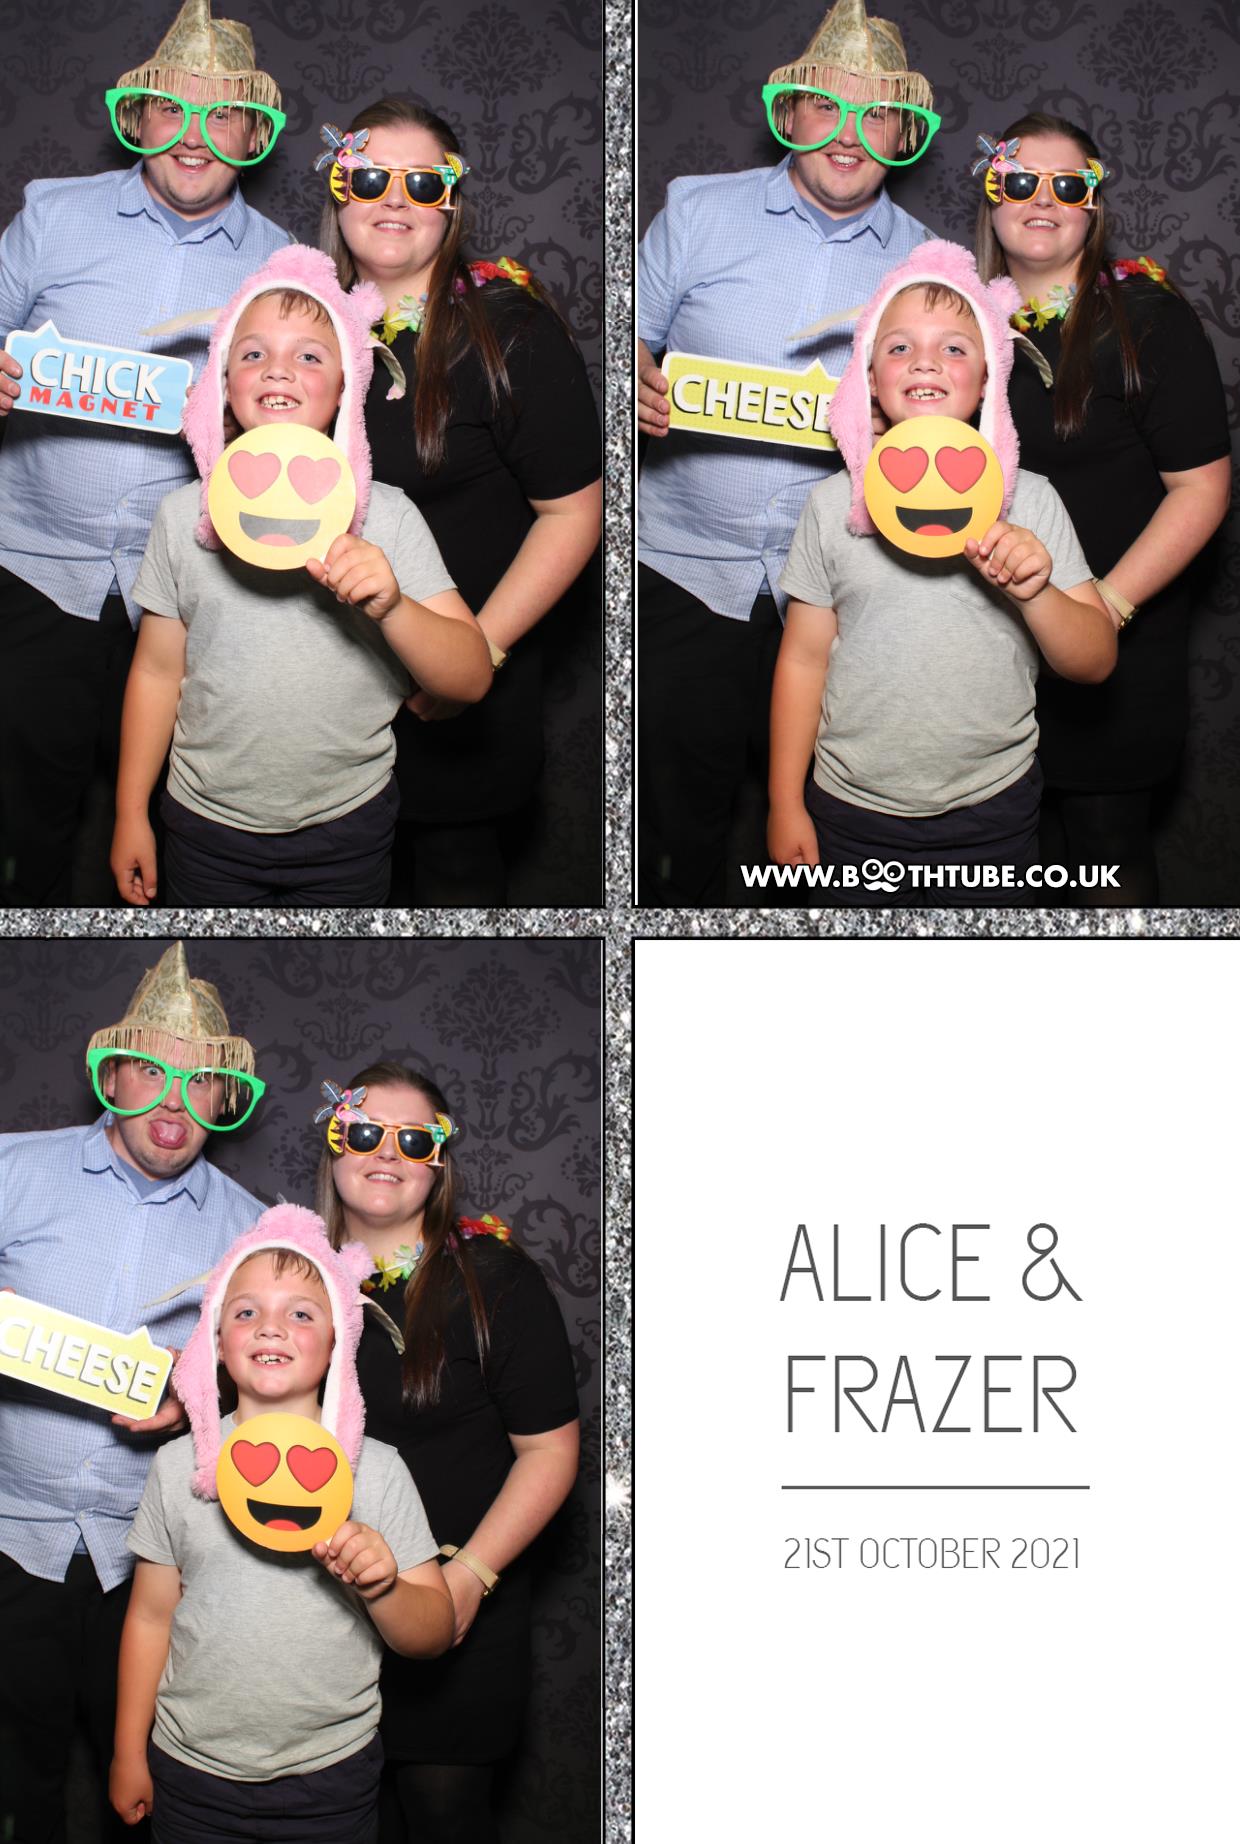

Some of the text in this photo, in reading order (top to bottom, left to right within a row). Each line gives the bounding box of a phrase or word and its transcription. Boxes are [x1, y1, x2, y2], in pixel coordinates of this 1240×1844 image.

[30, 386, 160, 421] MAGNET
[31, 348, 167, 404] CHICK
[0, 1317, 160, 1404] CHEESE
